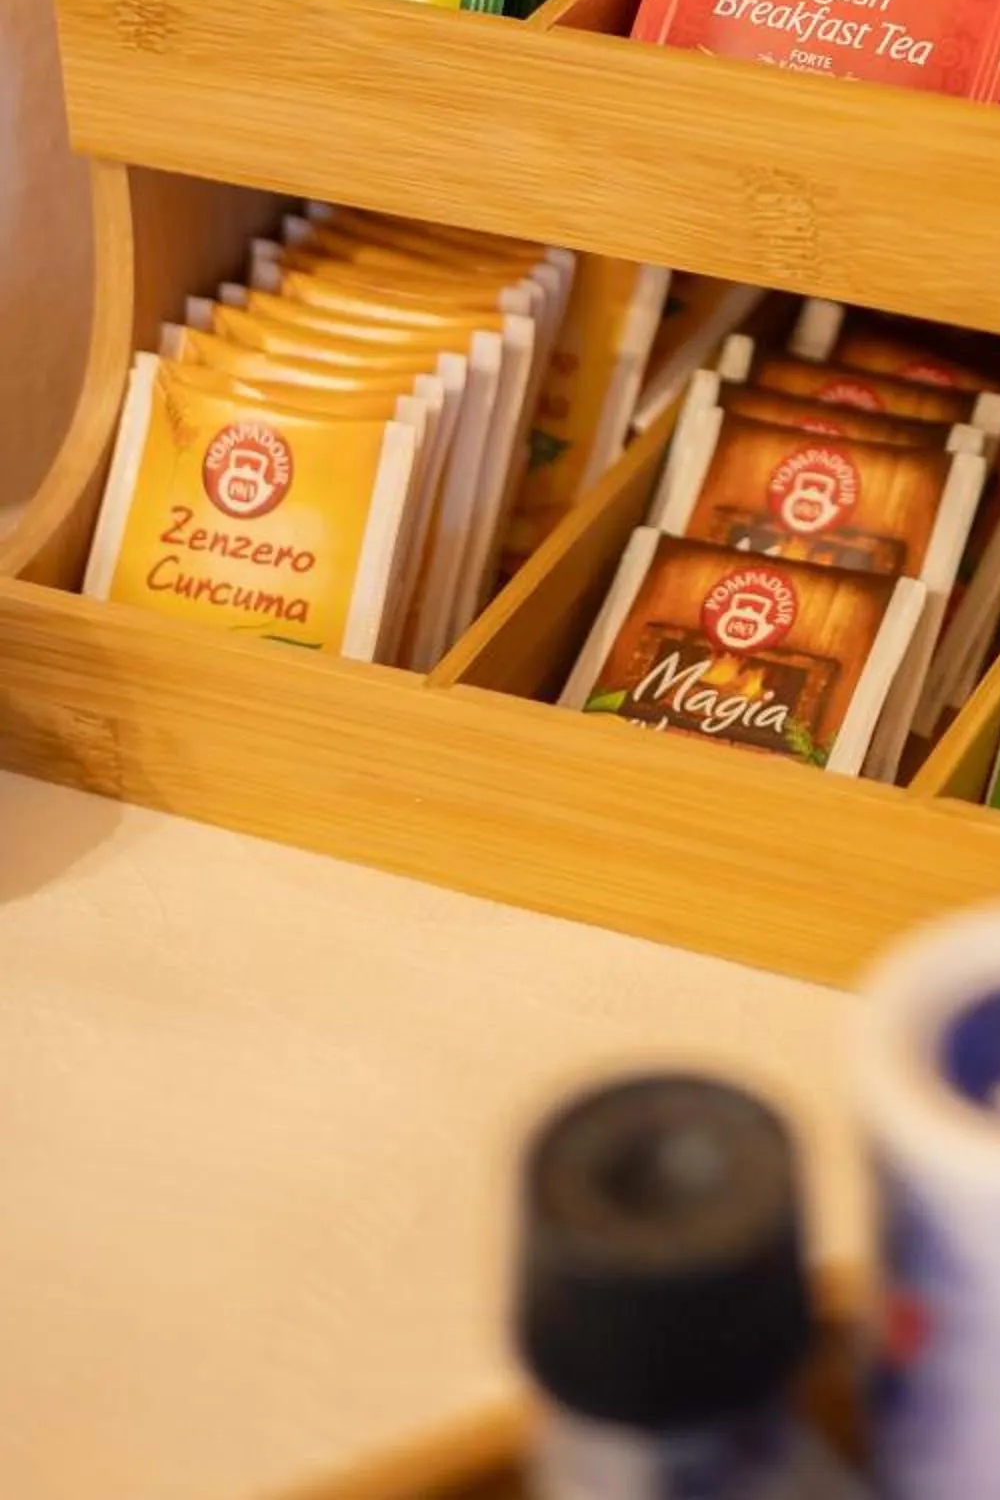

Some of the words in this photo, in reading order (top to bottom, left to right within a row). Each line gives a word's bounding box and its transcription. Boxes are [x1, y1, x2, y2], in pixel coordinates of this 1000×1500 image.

[790, 48, 833, 69] FORTE
[874, 21, 934, 66] Tea
[160, 505, 317, 574] Zenzero
[146, 554, 310, 624] Curcuma
[704, 571, 793, 624] POMPADOUR
[633, 651, 789, 733] Magia
